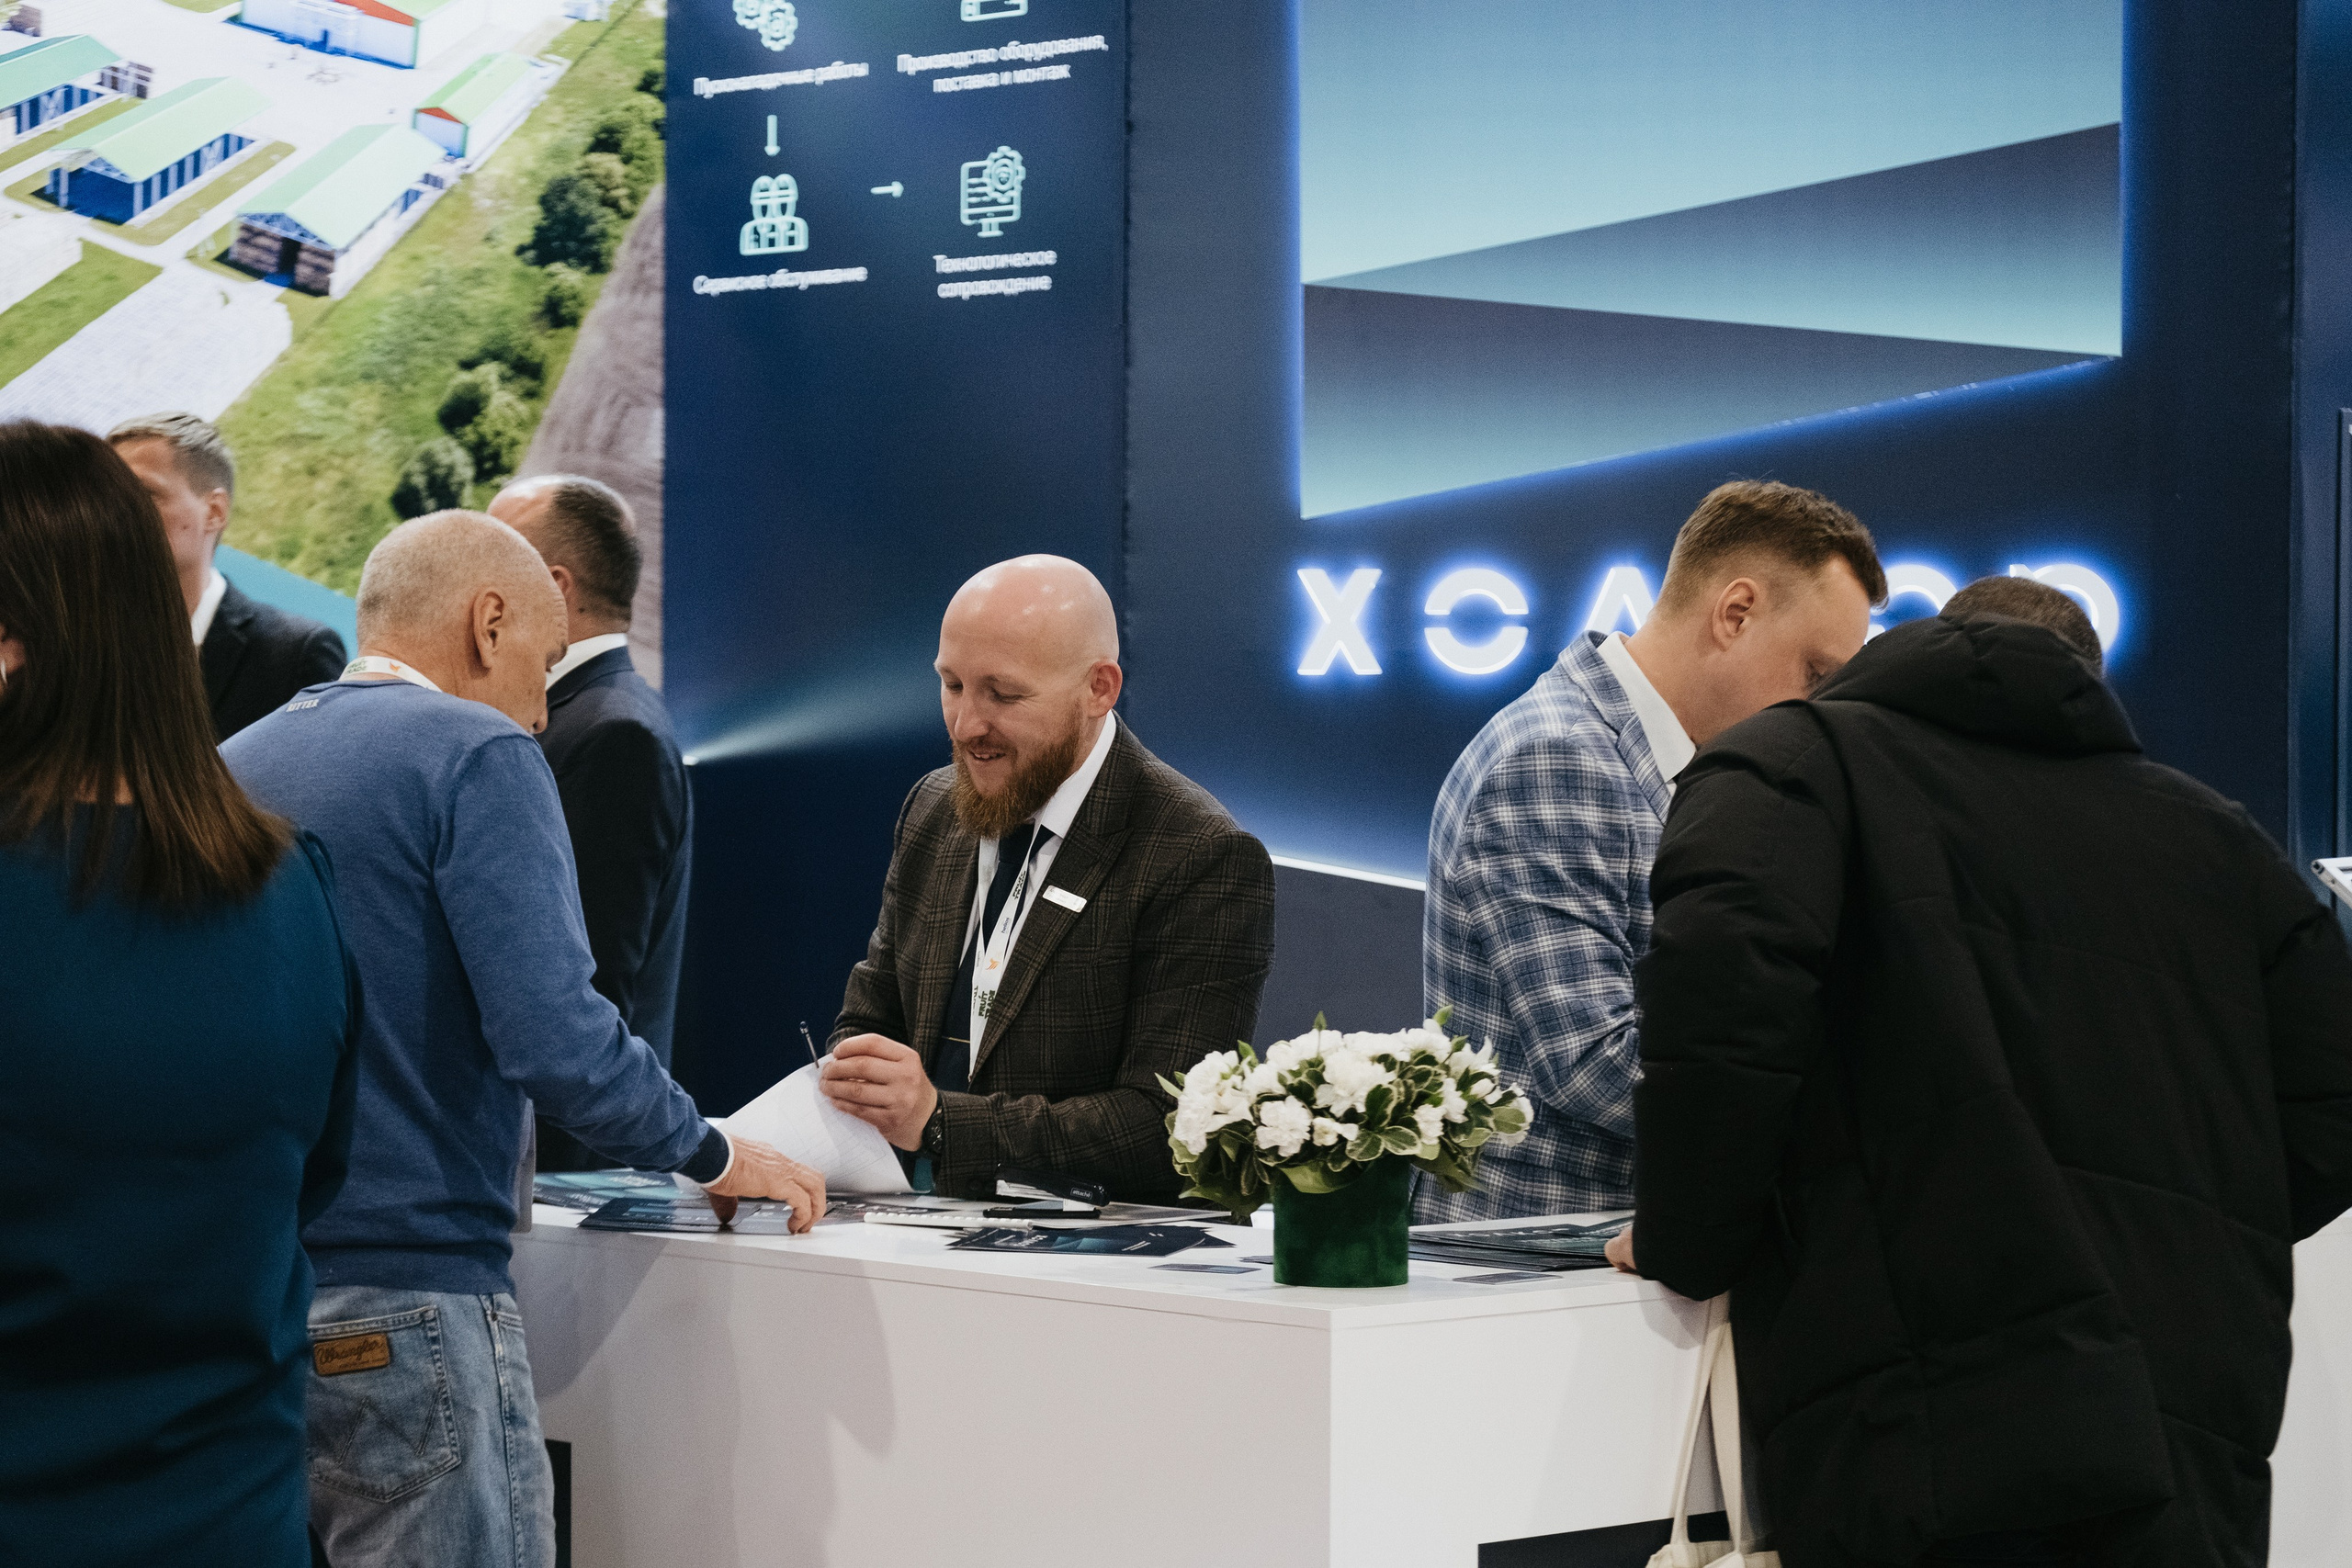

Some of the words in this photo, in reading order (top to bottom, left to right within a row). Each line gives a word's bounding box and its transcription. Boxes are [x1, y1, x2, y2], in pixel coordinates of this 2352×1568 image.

[933, 73, 1000, 93] поставка
[1000, 71, 1012, 85] и
[1012, 63, 1071, 84] монтаж
[933, 250, 1057, 274] Технологическое
[937, 275, 1053, 300] сопровождение
[318, 1339, 382, 1364] Wrangler
